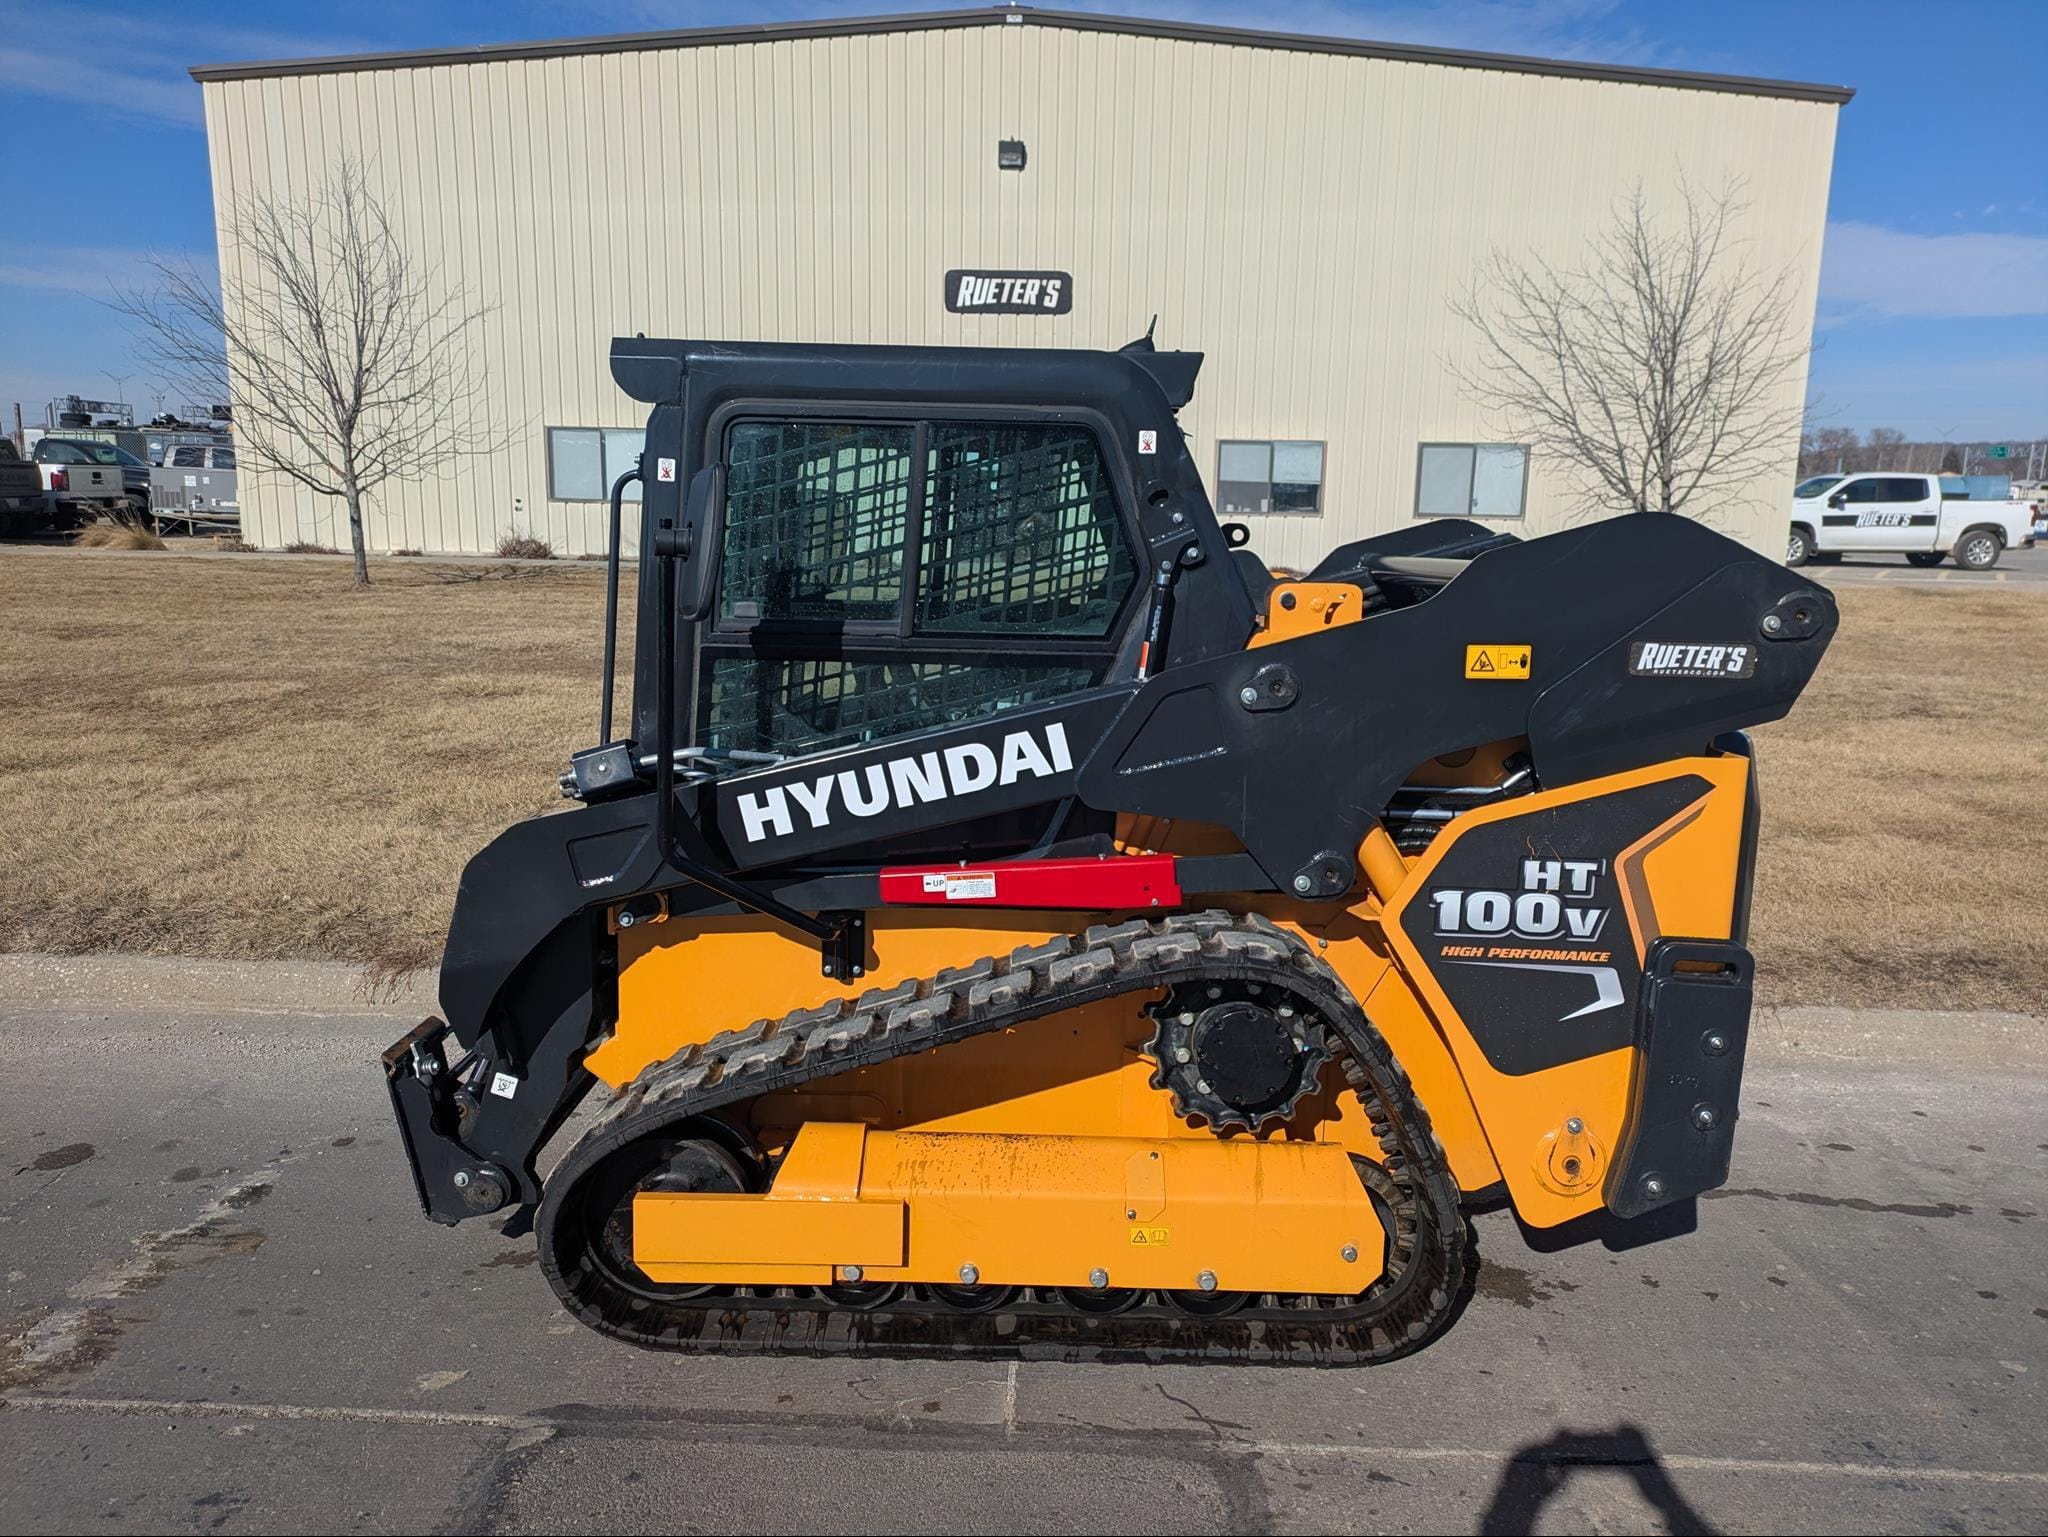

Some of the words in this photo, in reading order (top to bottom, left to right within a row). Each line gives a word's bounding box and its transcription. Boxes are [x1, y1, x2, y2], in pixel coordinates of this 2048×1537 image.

[956, 275, 1061, 308] RUETER'S
[1855, 512, 1912, 528] RUETER'S
[1637, 643, 1747, 671] RUETER'S
[737, 722, 1073, 842] HYUNDAI
[932, 879, 944, 887] UP
[1524, 860, 1598, 891] HT
[1441, 946, 1483, 957] HIGH
[1488, 948, 1611, 962] PERFORMANCE
